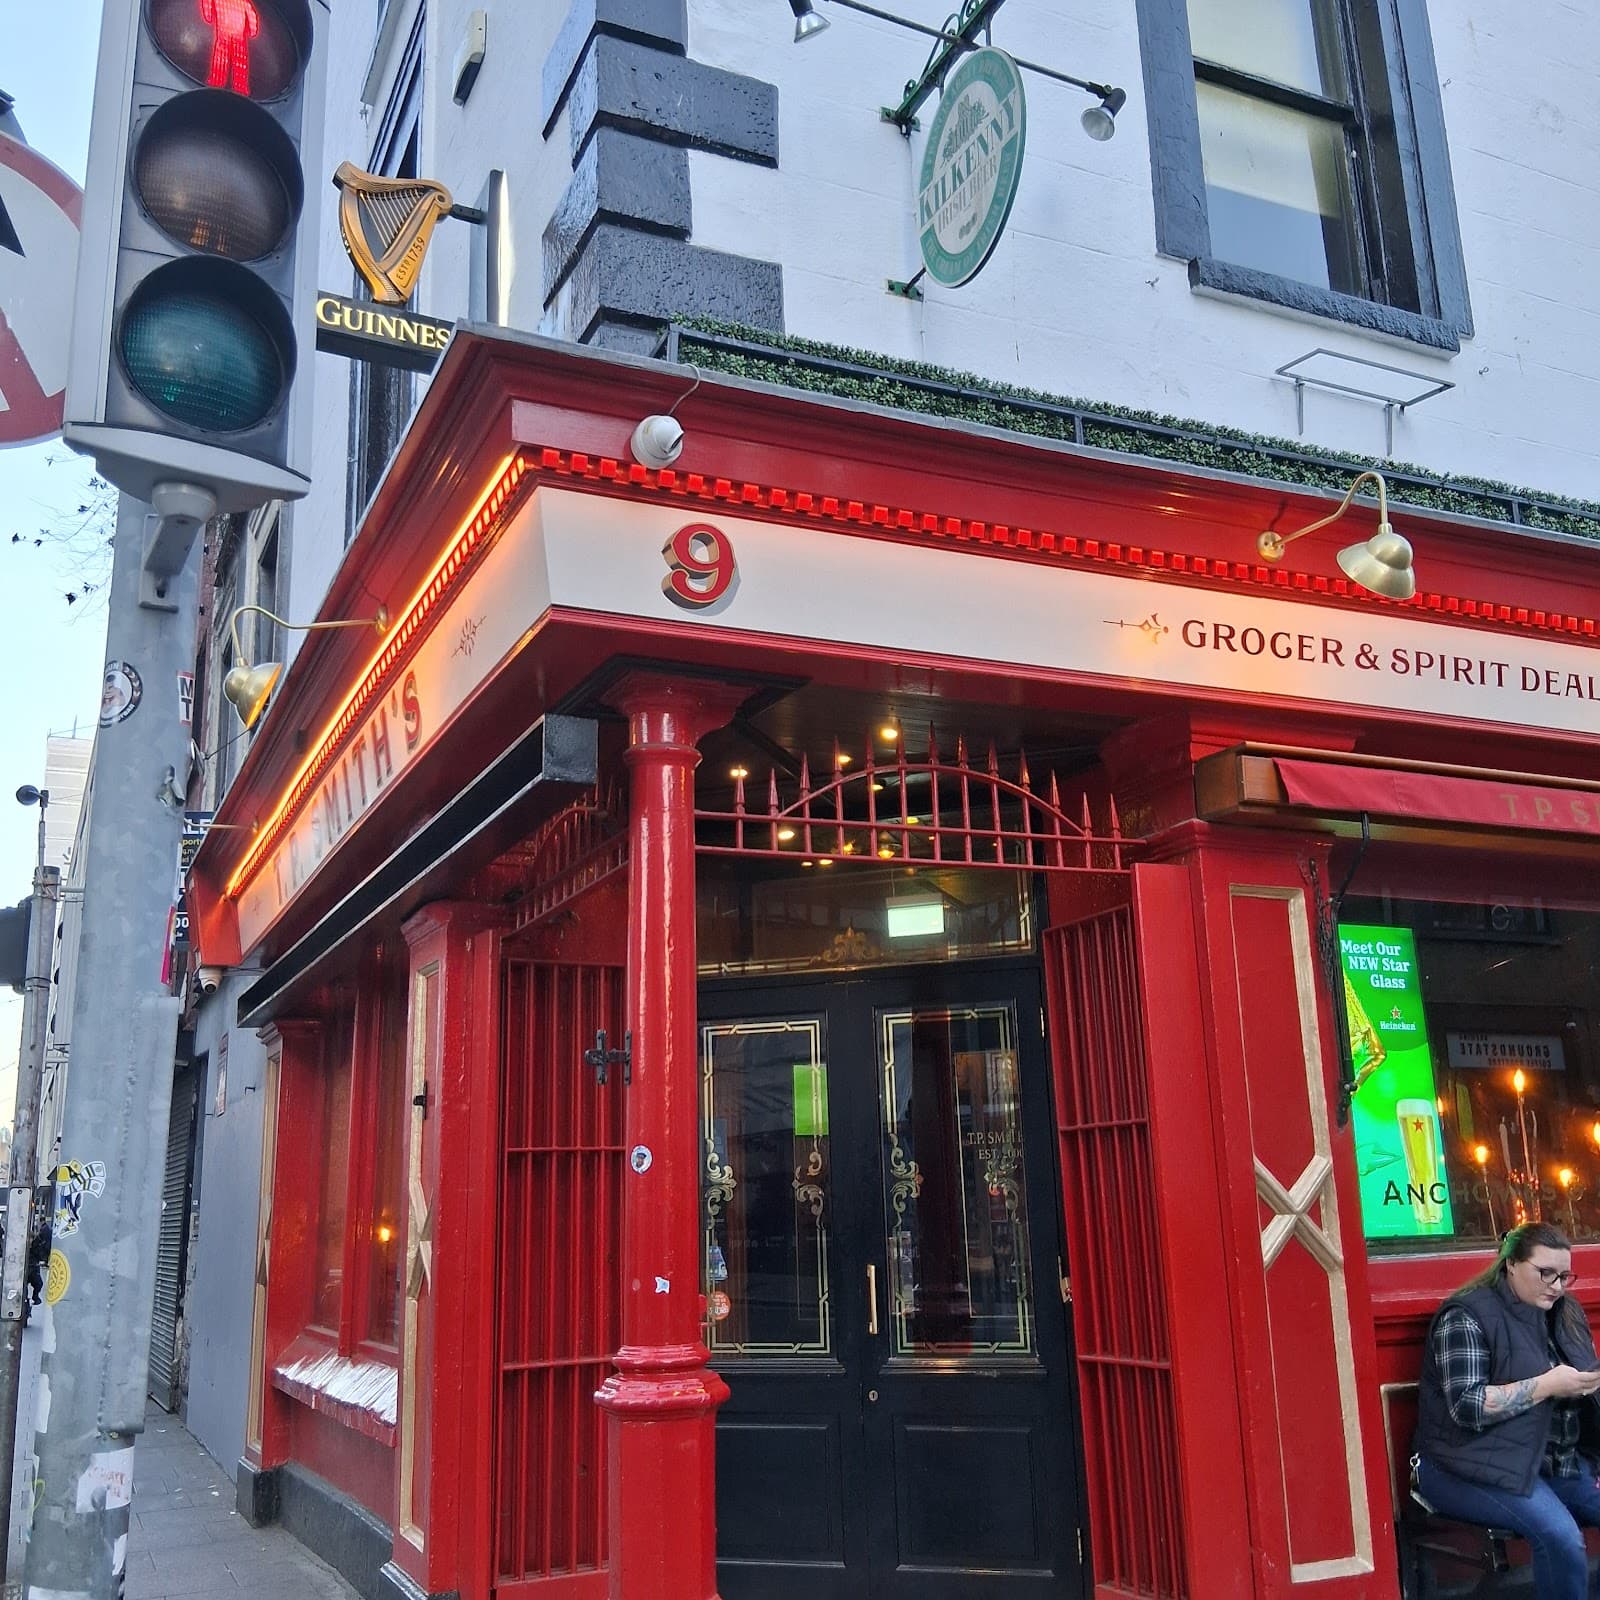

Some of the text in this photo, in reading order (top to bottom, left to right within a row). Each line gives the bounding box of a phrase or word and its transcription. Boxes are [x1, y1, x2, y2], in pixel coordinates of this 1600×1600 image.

[919, 90, 1018, 229] KILKENNY
[938, 187, 968, 235] IRISH
[408, 236, 425, 263] 1759
[661, 521, 740, 616] 9
[1354, 642, 1382, 672] &
[1389, 646, 1510, 689] SPIRIT
[1520, 664, 1600, 702] DEAL
[1340, 940, 1402, 956] Meet Our
[1348, 955, 1411, 973] NEW Star
[1370, 973, 1406, 989] Glass
[1379, 1020, 1417, 1031] Heineken
